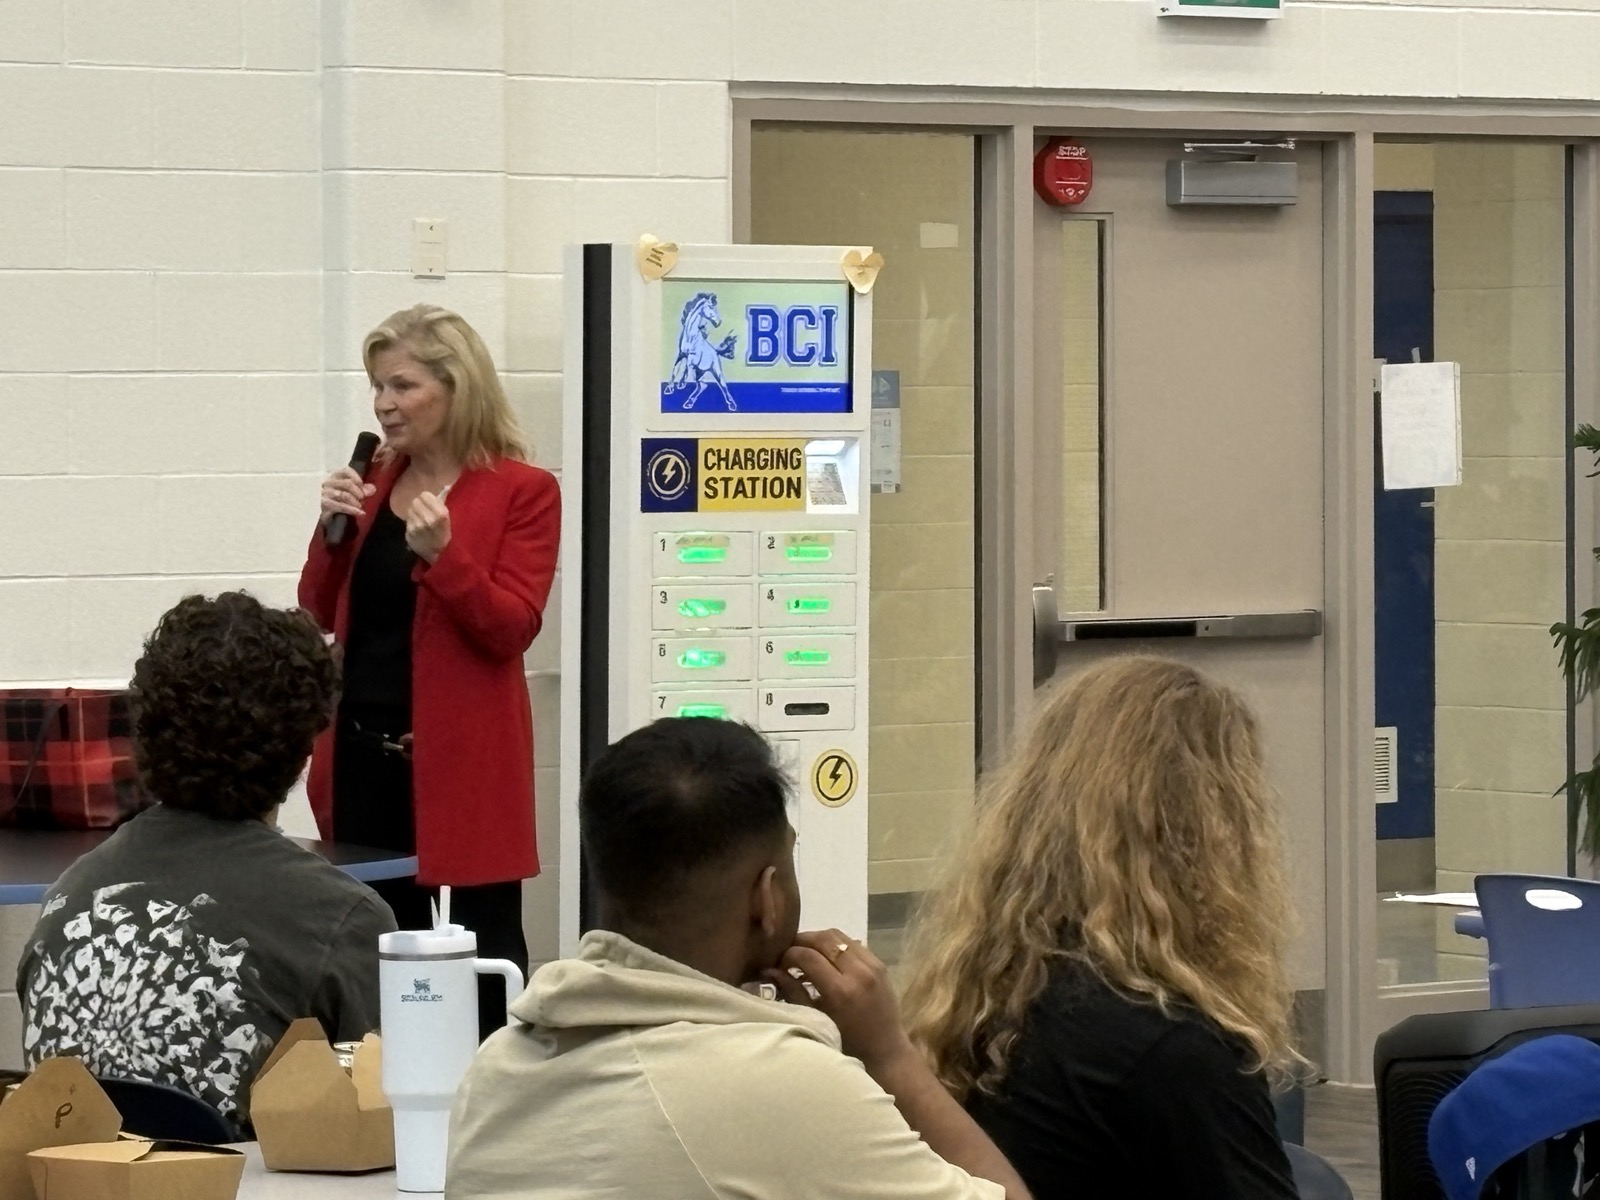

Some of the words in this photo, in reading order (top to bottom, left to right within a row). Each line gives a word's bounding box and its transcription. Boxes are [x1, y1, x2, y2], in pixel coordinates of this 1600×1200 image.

[746, 305, 838, 366] BCI
[704, 448, 802, 471] CHARGING
[704, 476, 802, 499] STATION
[658, 696, 666, 709] 7
